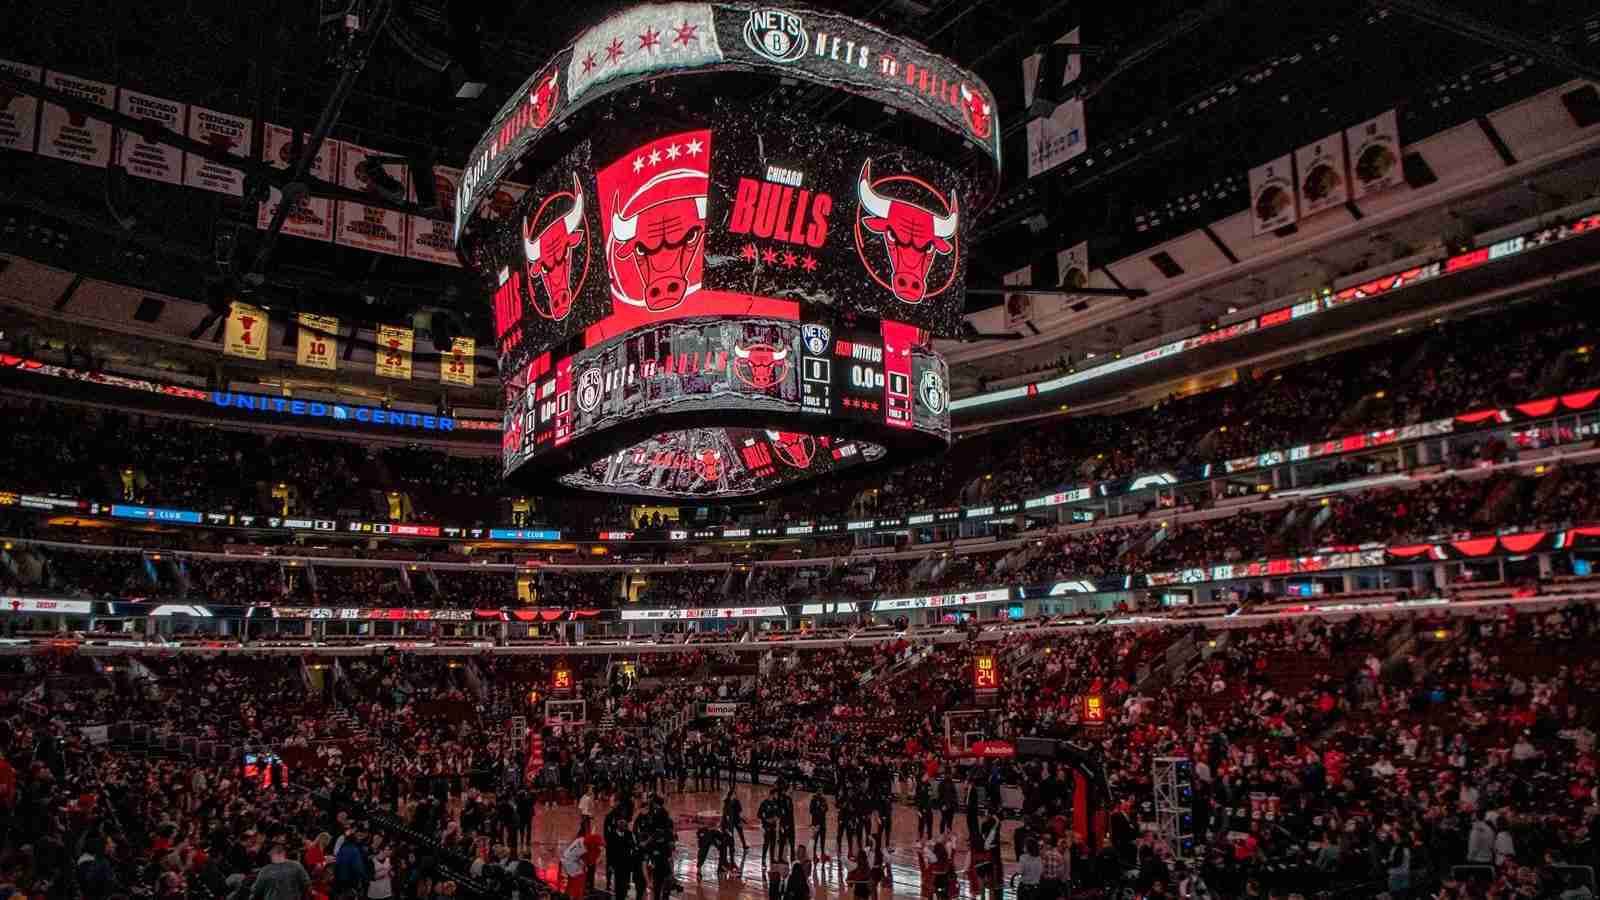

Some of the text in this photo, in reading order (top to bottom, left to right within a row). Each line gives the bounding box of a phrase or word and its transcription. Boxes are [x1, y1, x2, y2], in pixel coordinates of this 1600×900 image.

[753, 10, 800, 36] NETS
[815, 32, 869, 69] NETS
[128, 96, 178, 113] CHICAGO
[198, 112, 244, 129] CHICAGO
[766, 166, 803, 187] CHICAGO
[729, 176, 832, 248] BULLS
[802, 326, 829, 341] NETS
[309, 342, 326, 356] 10
[852, 343, 871, 361] WITH
[871, 345, 882, 362] US
[606, 363, 635, 393] NETS
[852, 365, 874, 388] 0.0
[213, 390, 331, 418] UNITED
[355, 408, 456, 431] CENTER
[555, 678, 569, 688] 24
[977, 670, 994, 686] 24
